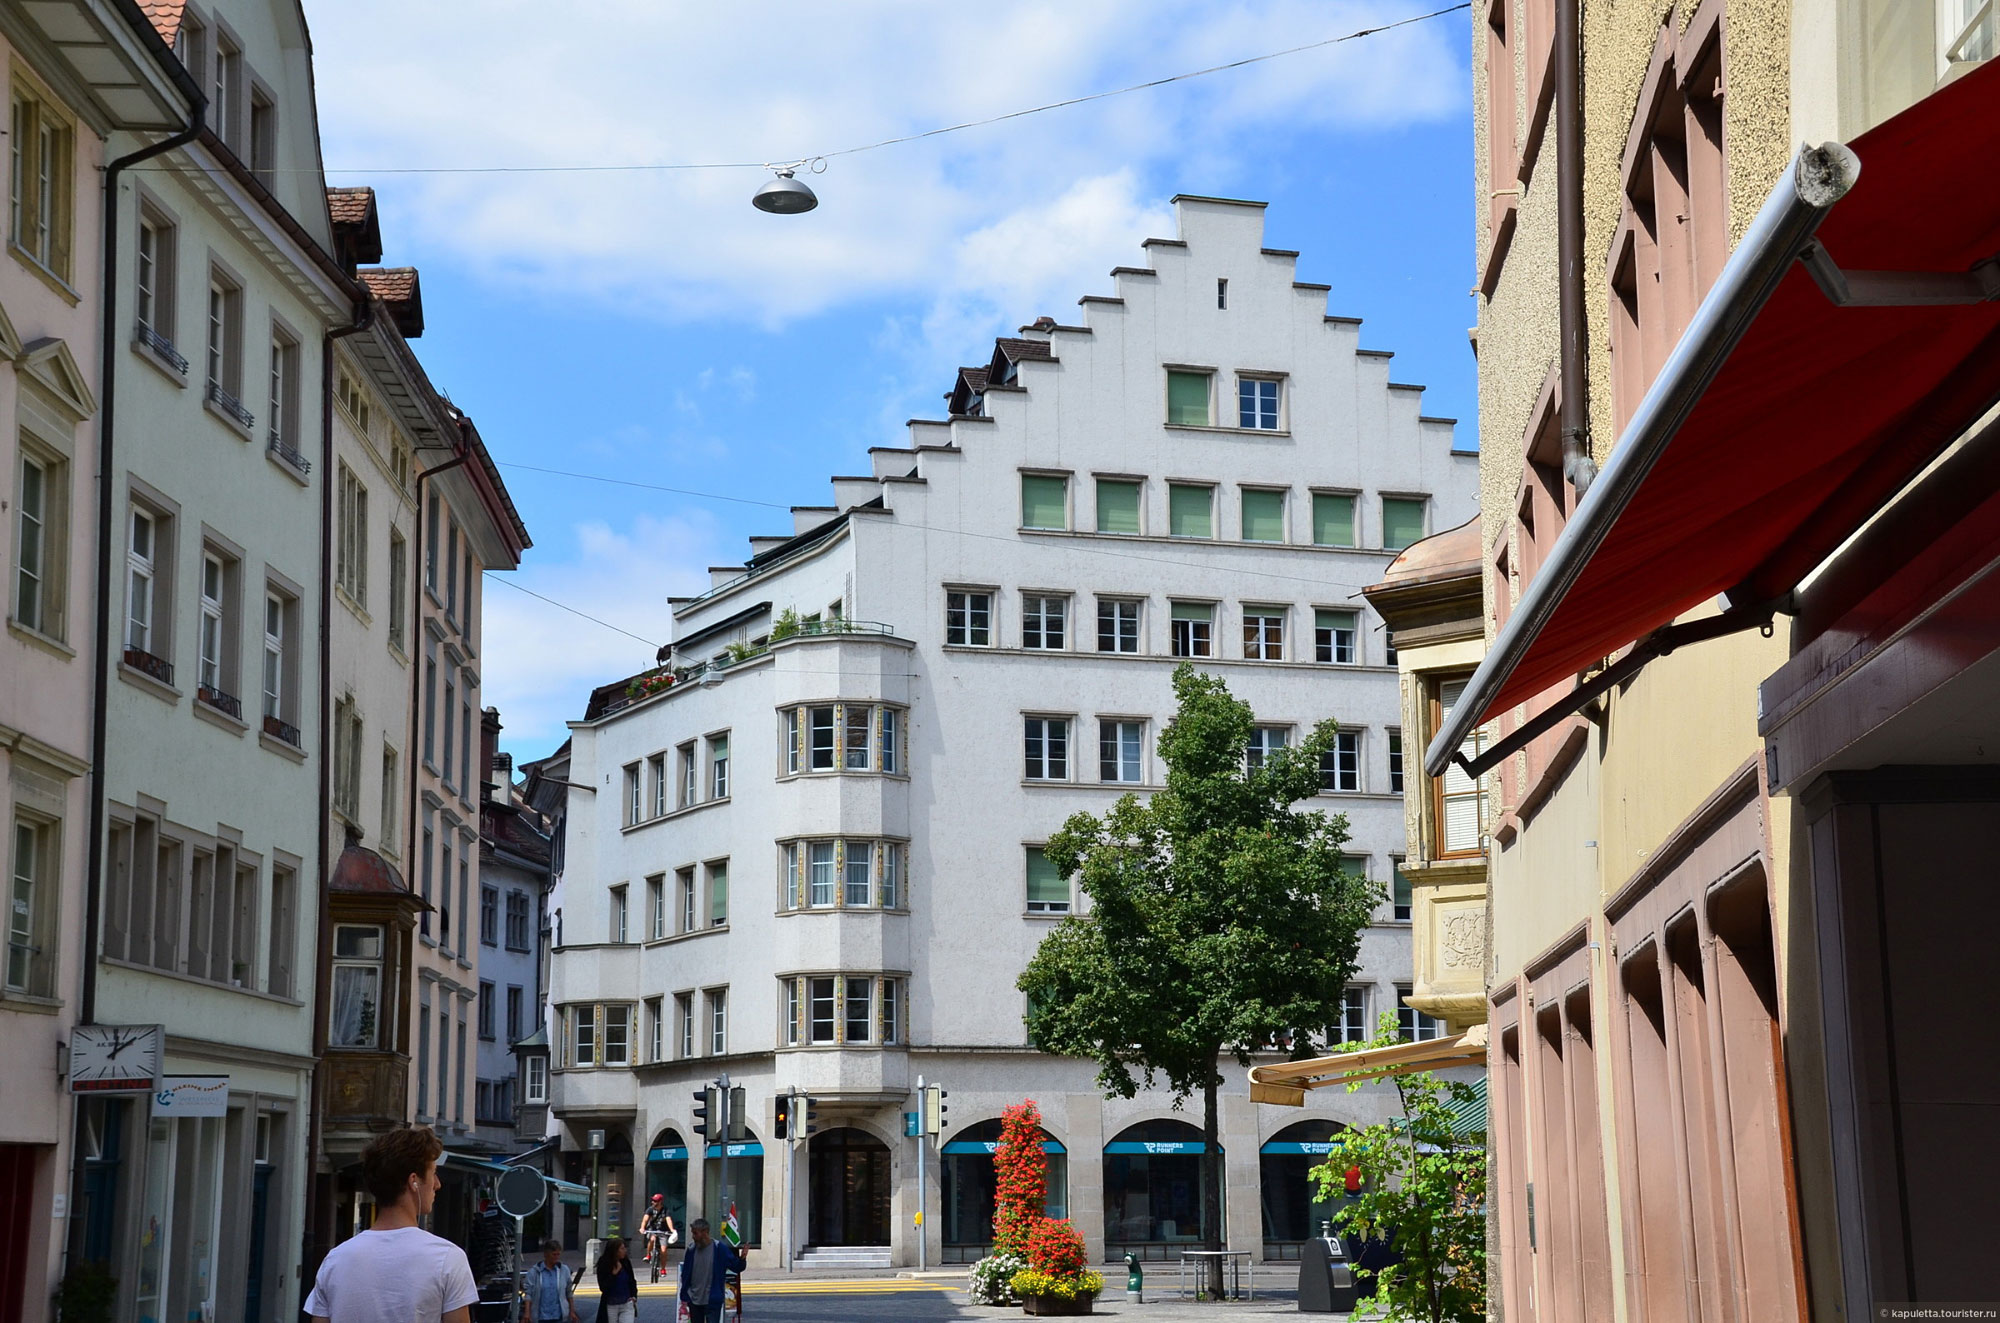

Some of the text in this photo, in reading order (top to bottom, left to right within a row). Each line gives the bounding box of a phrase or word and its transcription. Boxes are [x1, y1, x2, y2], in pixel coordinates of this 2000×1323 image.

[73, 1079, 151, 1091] CERTINA
[172, 1082, 227, 1092] KLEINE INSEL
